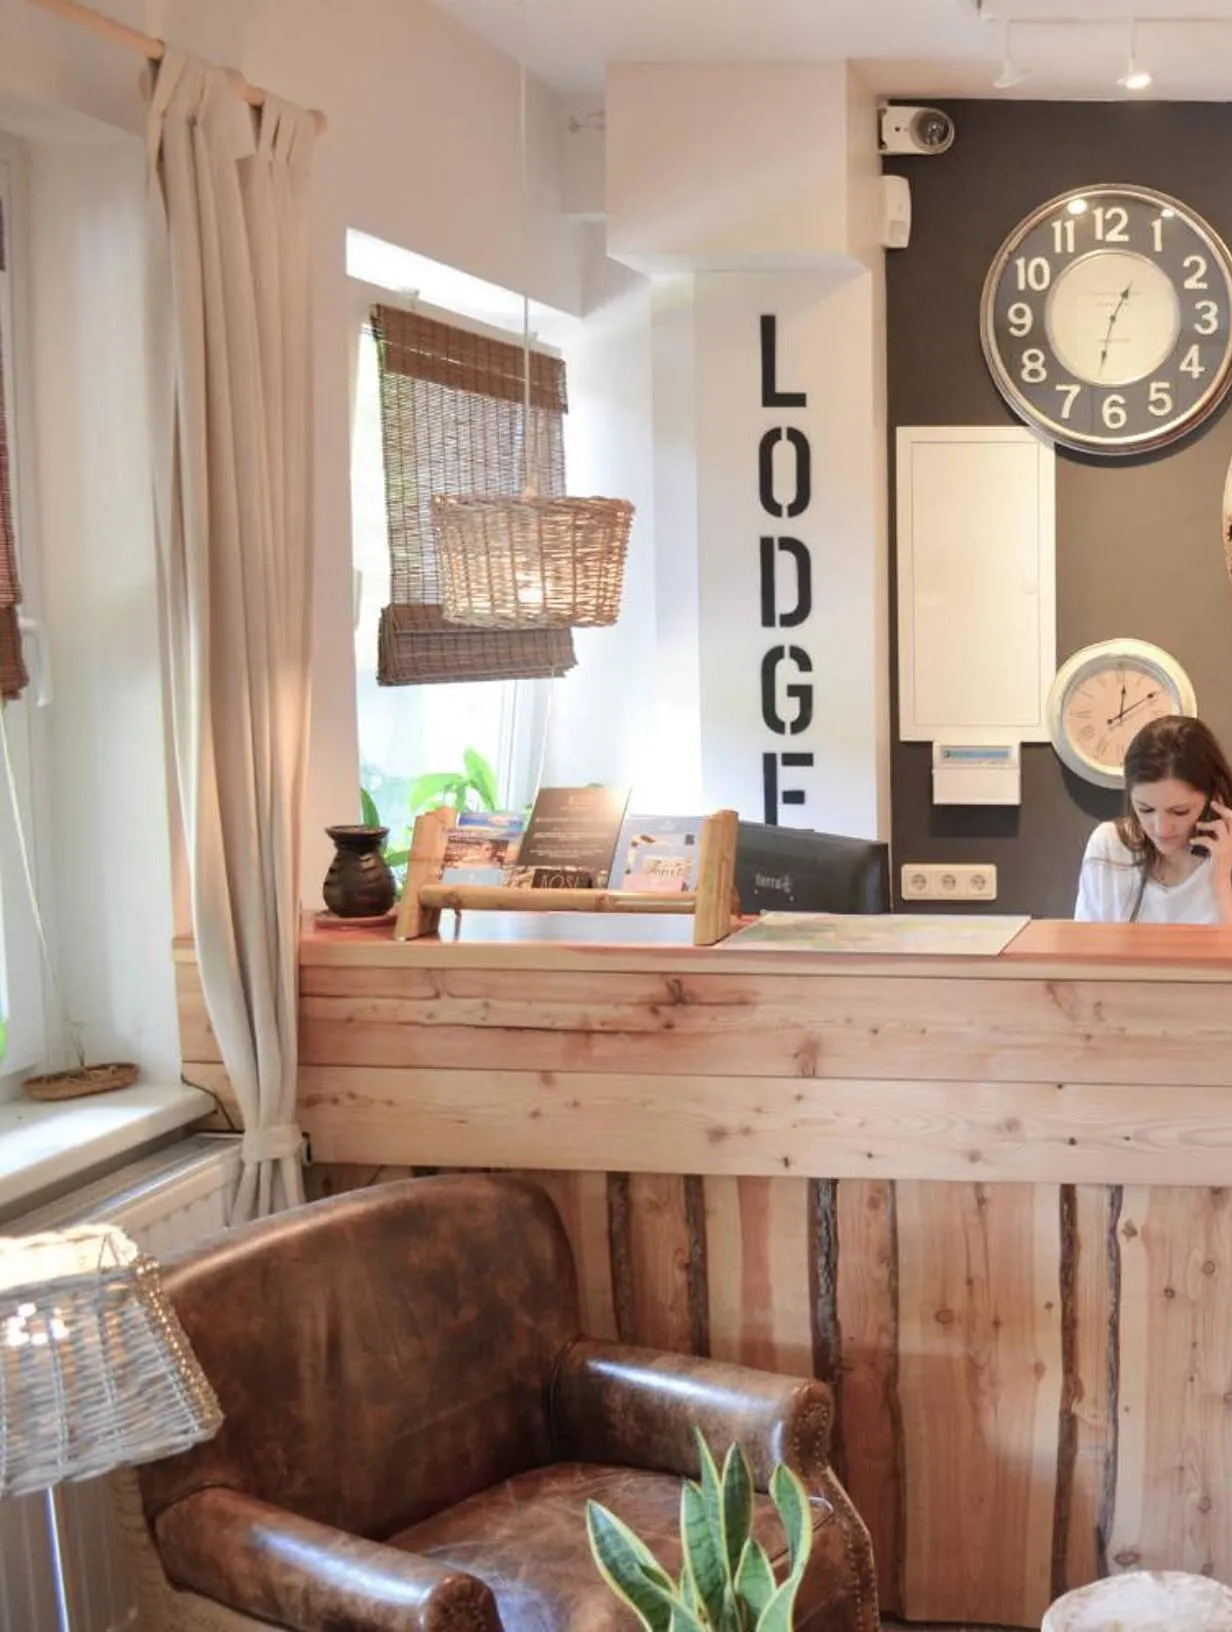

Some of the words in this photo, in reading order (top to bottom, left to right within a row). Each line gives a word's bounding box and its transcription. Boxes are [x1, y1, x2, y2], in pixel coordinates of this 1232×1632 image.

[1052, 220, 1075, 252] 11
[1093, 208, 1130, 242] 12
[1152, 219, 1162, 252] 1
[1016, 257, 1050, 291] 10
[1183, 256, 1208, 289] 2
[1008, 303, 1032, 336] 9
[1194, 301, 1218, 334] 3
[1021, 349, 1047, 382] 8
[1180, 344, 1205, 379] 4
[1056, 384, 1081, 418] 7
[1102, 394, 1126, 429] 6
[1148, 382, 1172, 416] 5
[759, 314, 814, 830] LODGE
